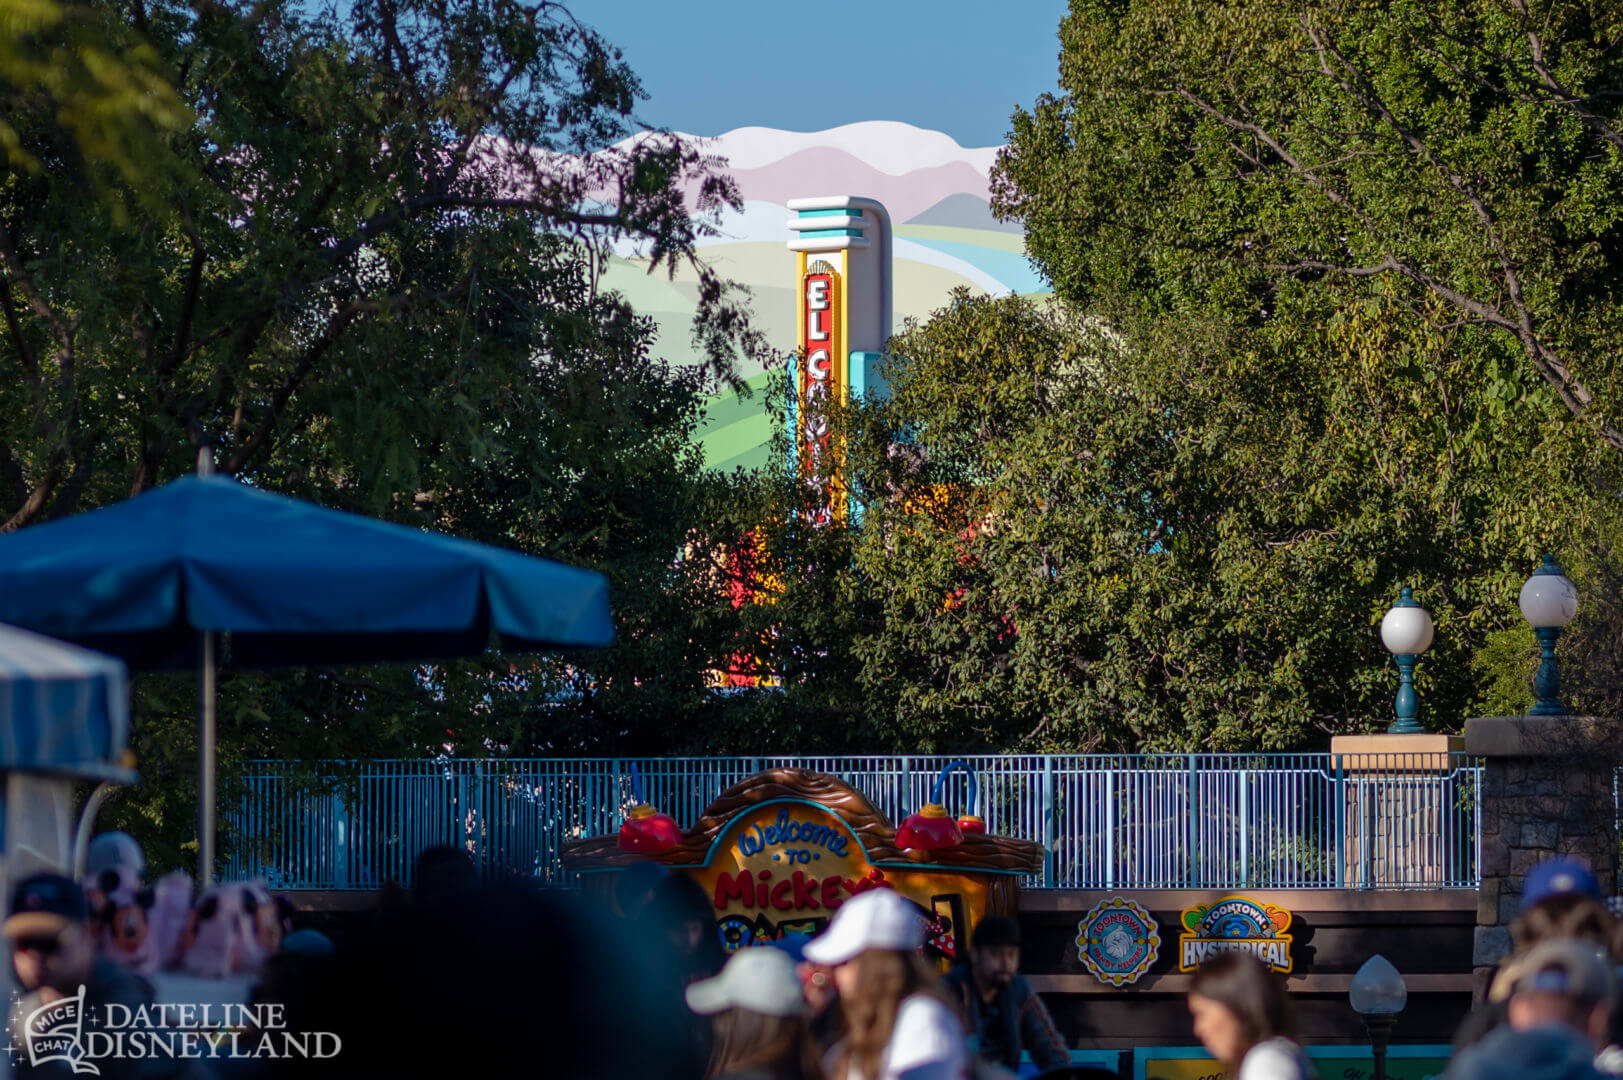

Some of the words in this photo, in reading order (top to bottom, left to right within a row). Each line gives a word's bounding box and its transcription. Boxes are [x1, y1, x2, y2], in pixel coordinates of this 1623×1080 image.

[807, 279, 828, 341] EL
[738, 807, 848, 857] Welcome
[786, 850, 811, 865] TO
[1093, 912, 1143, 936] TOONTOWN
[1206, 903, 1266, 926] TOONTOWN
